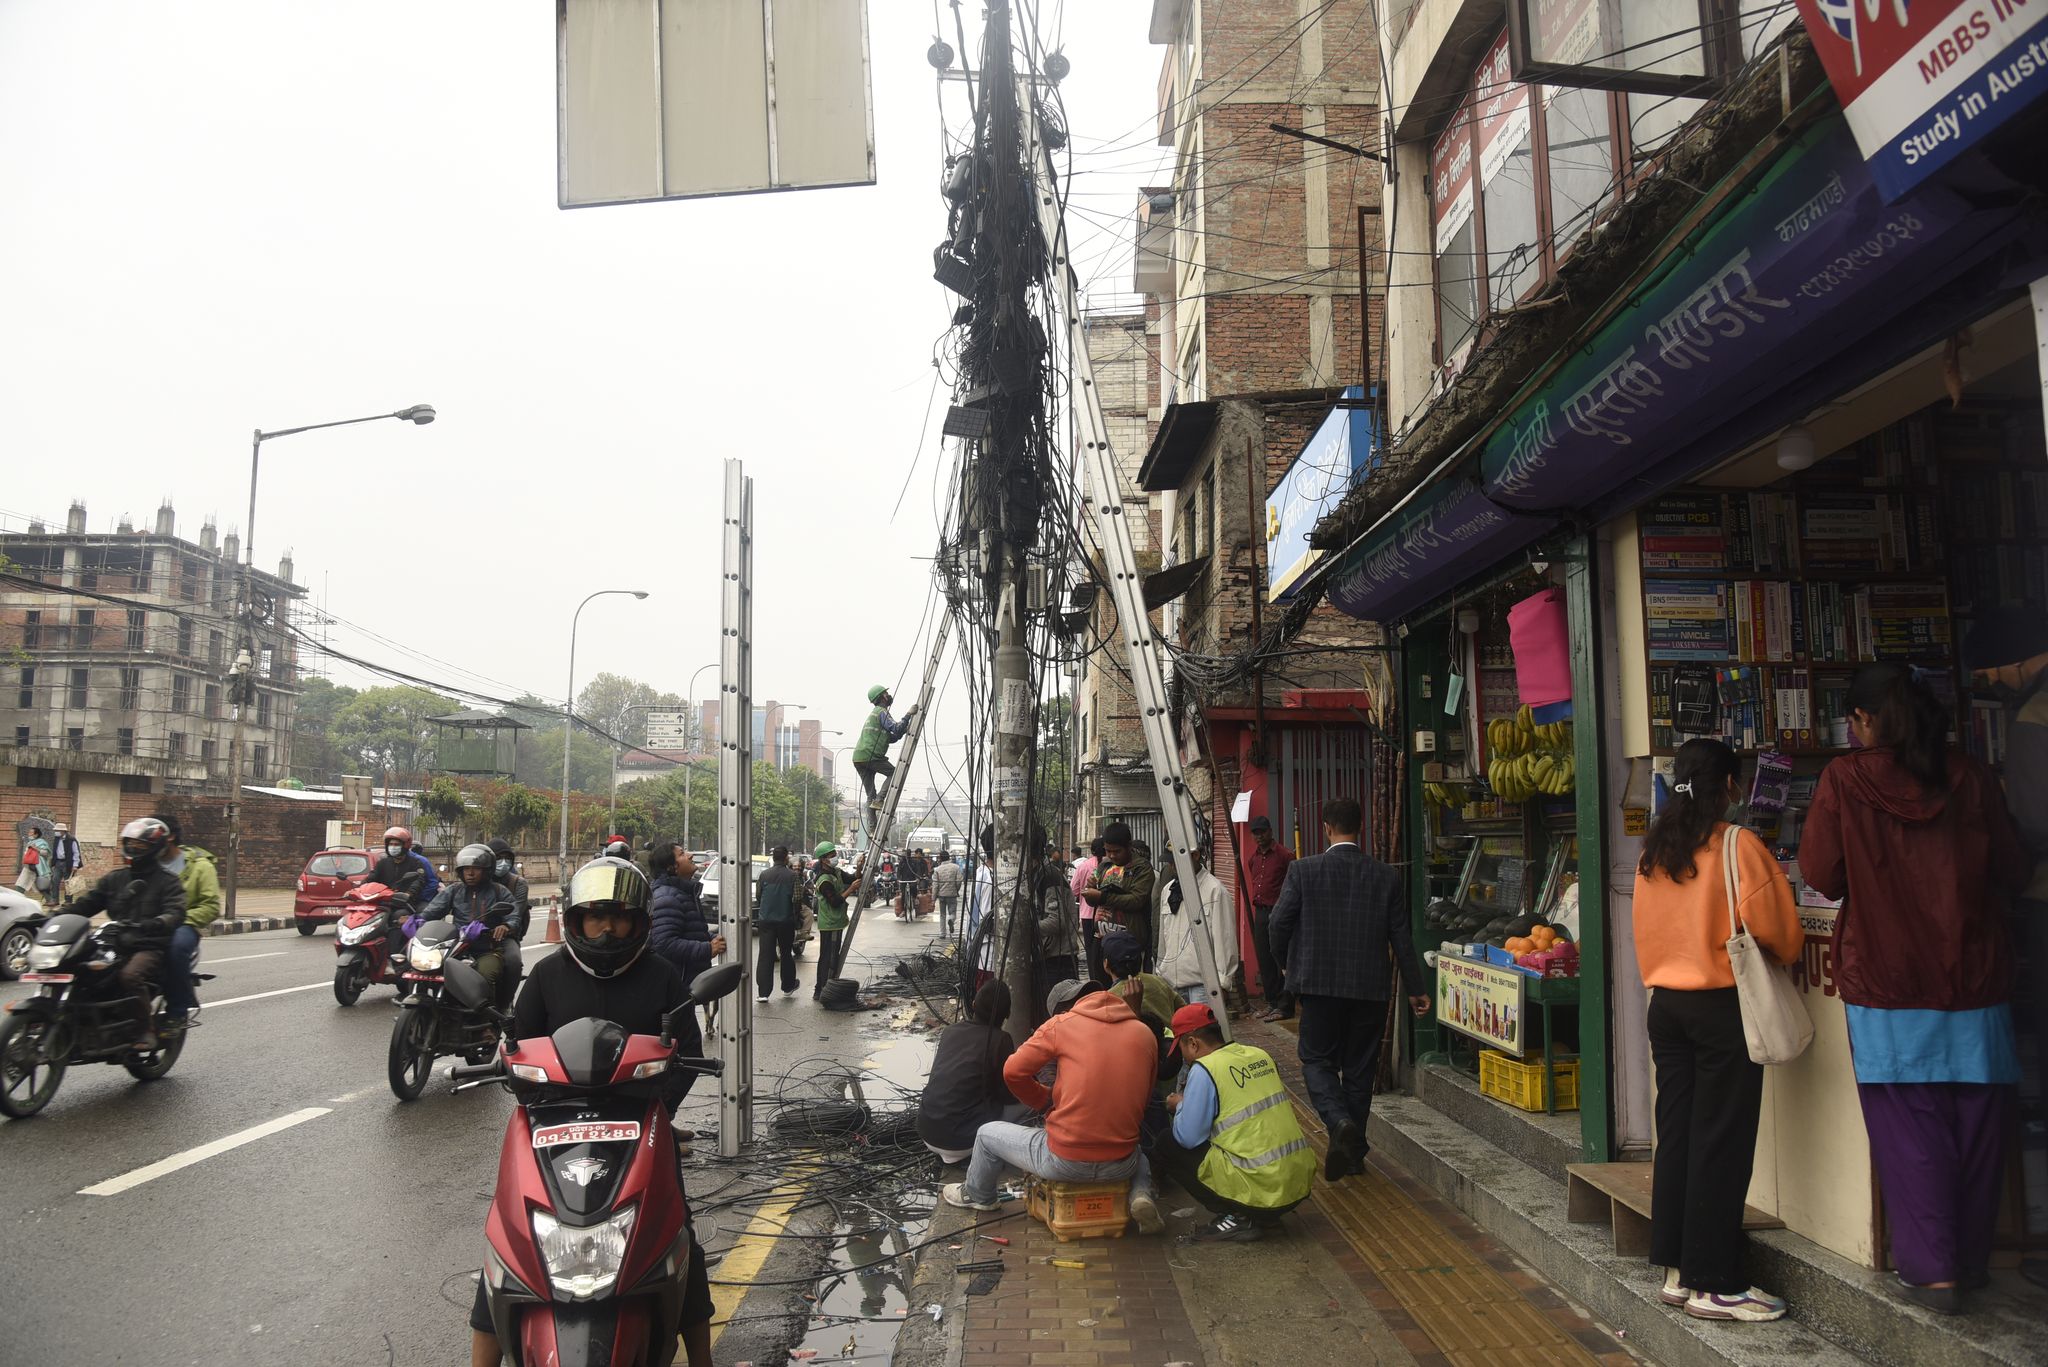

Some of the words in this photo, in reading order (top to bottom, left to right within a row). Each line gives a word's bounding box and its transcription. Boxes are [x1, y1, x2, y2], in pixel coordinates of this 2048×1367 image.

[1918, 10, 1991, 85] MBBS
[1901, 109, 1961, 165] Study
[1957, 91, 1987, 120] in
[1560, 344, 1664, 445] पुस्तक
[1645, 246, 1791, 370] भण्डार
